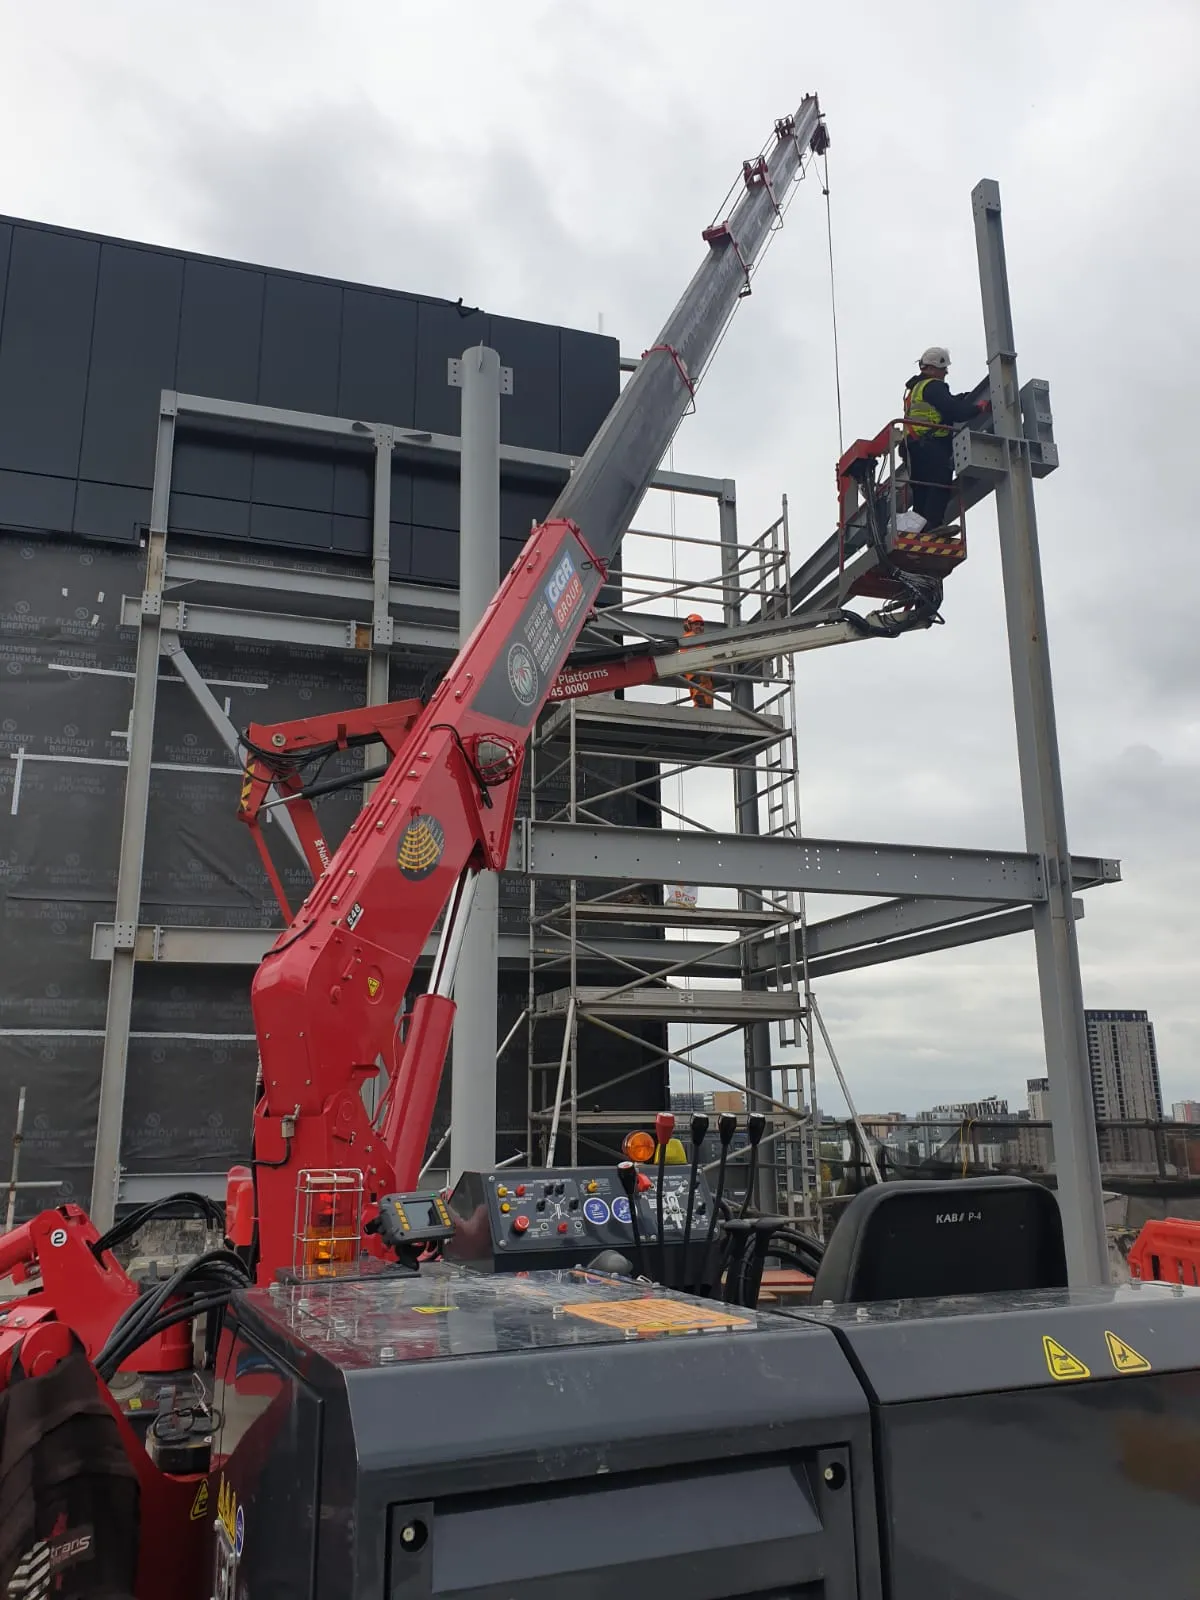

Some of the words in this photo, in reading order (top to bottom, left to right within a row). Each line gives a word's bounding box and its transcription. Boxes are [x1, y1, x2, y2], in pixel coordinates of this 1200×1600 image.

[550, 557, 573, 603] GGR
[556, 579, 580, 623] GROUP
[558, 669, 609, 684] Platforms
[565, 682, 589, 695] 0000
[53, 1231, 64, 1244] 2
